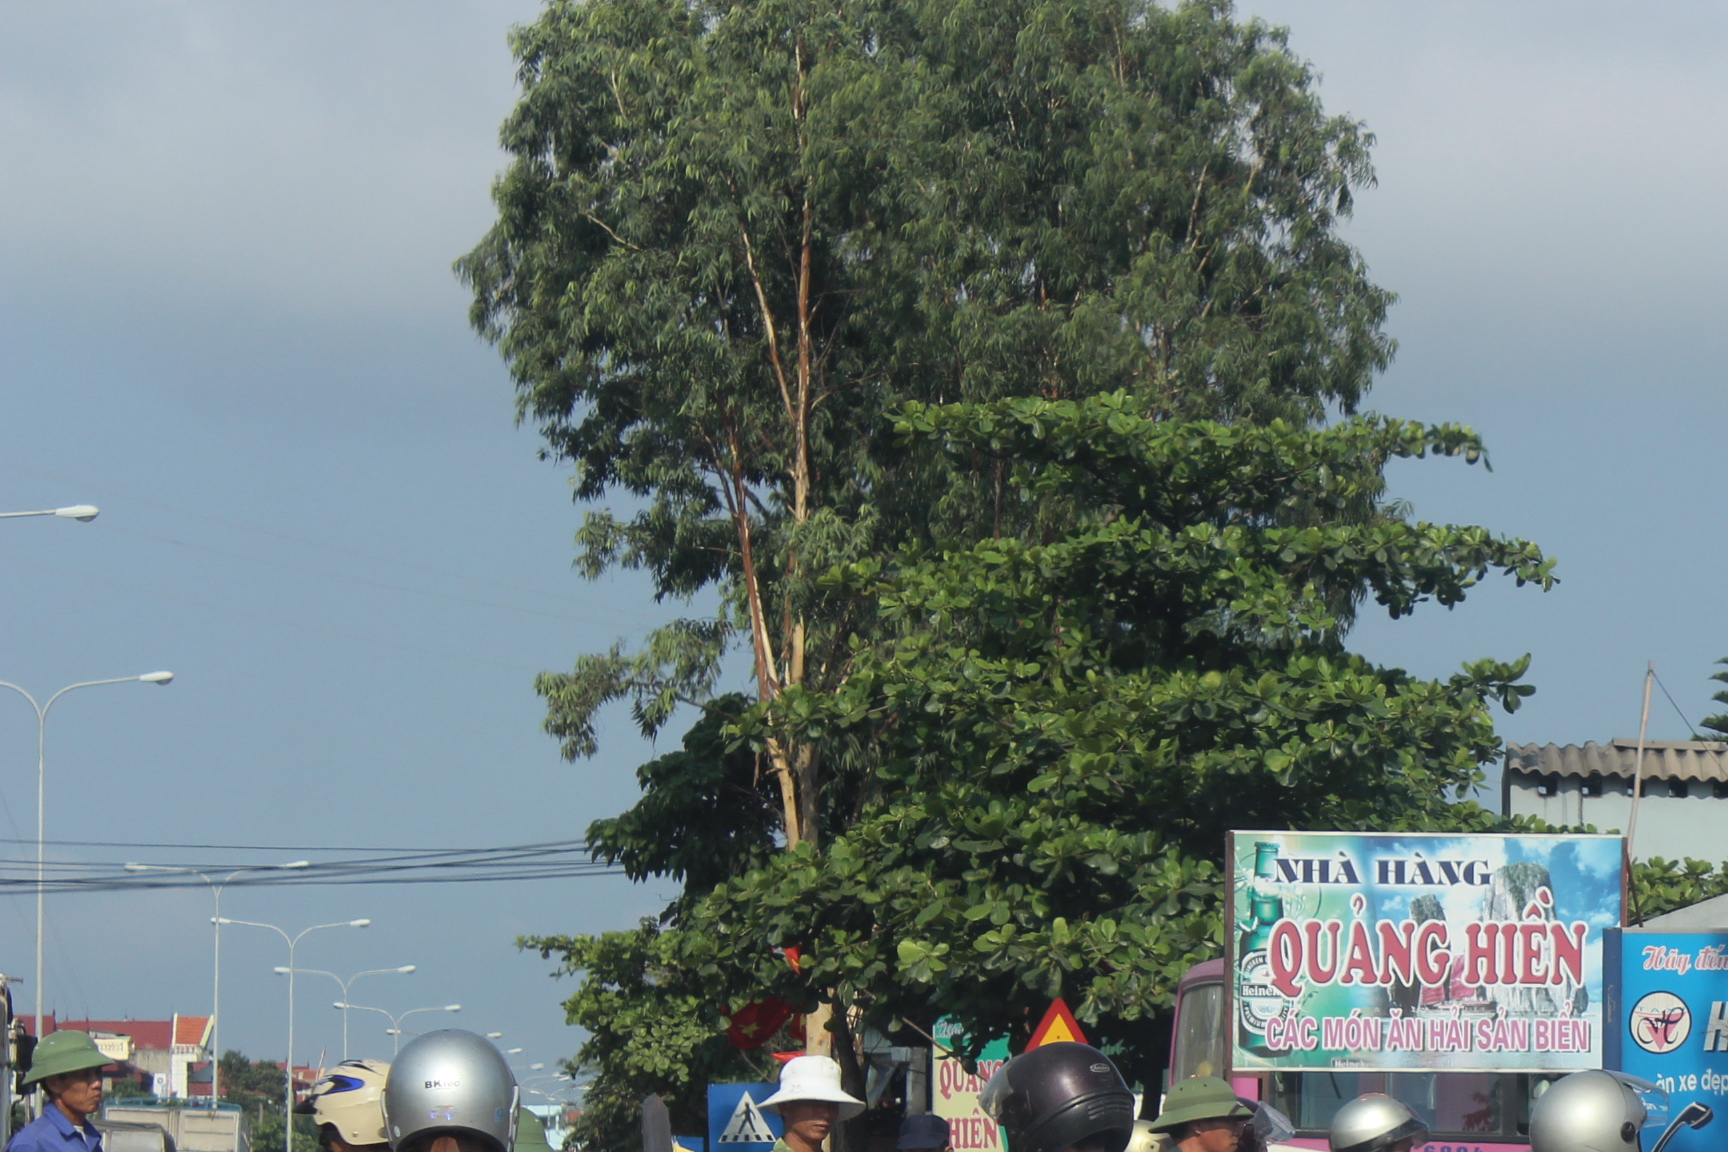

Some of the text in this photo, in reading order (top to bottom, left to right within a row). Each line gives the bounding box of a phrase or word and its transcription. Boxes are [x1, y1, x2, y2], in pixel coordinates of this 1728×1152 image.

[1275, 852, 1491, 886] NHÀ HÀNG
[1270, 887, 1589, 998] QUẢNG HIỀN
[1642, 945, 1691, 975] Hãy
[1266, 1001, 1589, 1051] CÁC MÓN ĂN HẢI SẢN BIỂN
[1655, 1073, 1675, 1094] àn
[1679, 1074, 1697, 1092] xe
